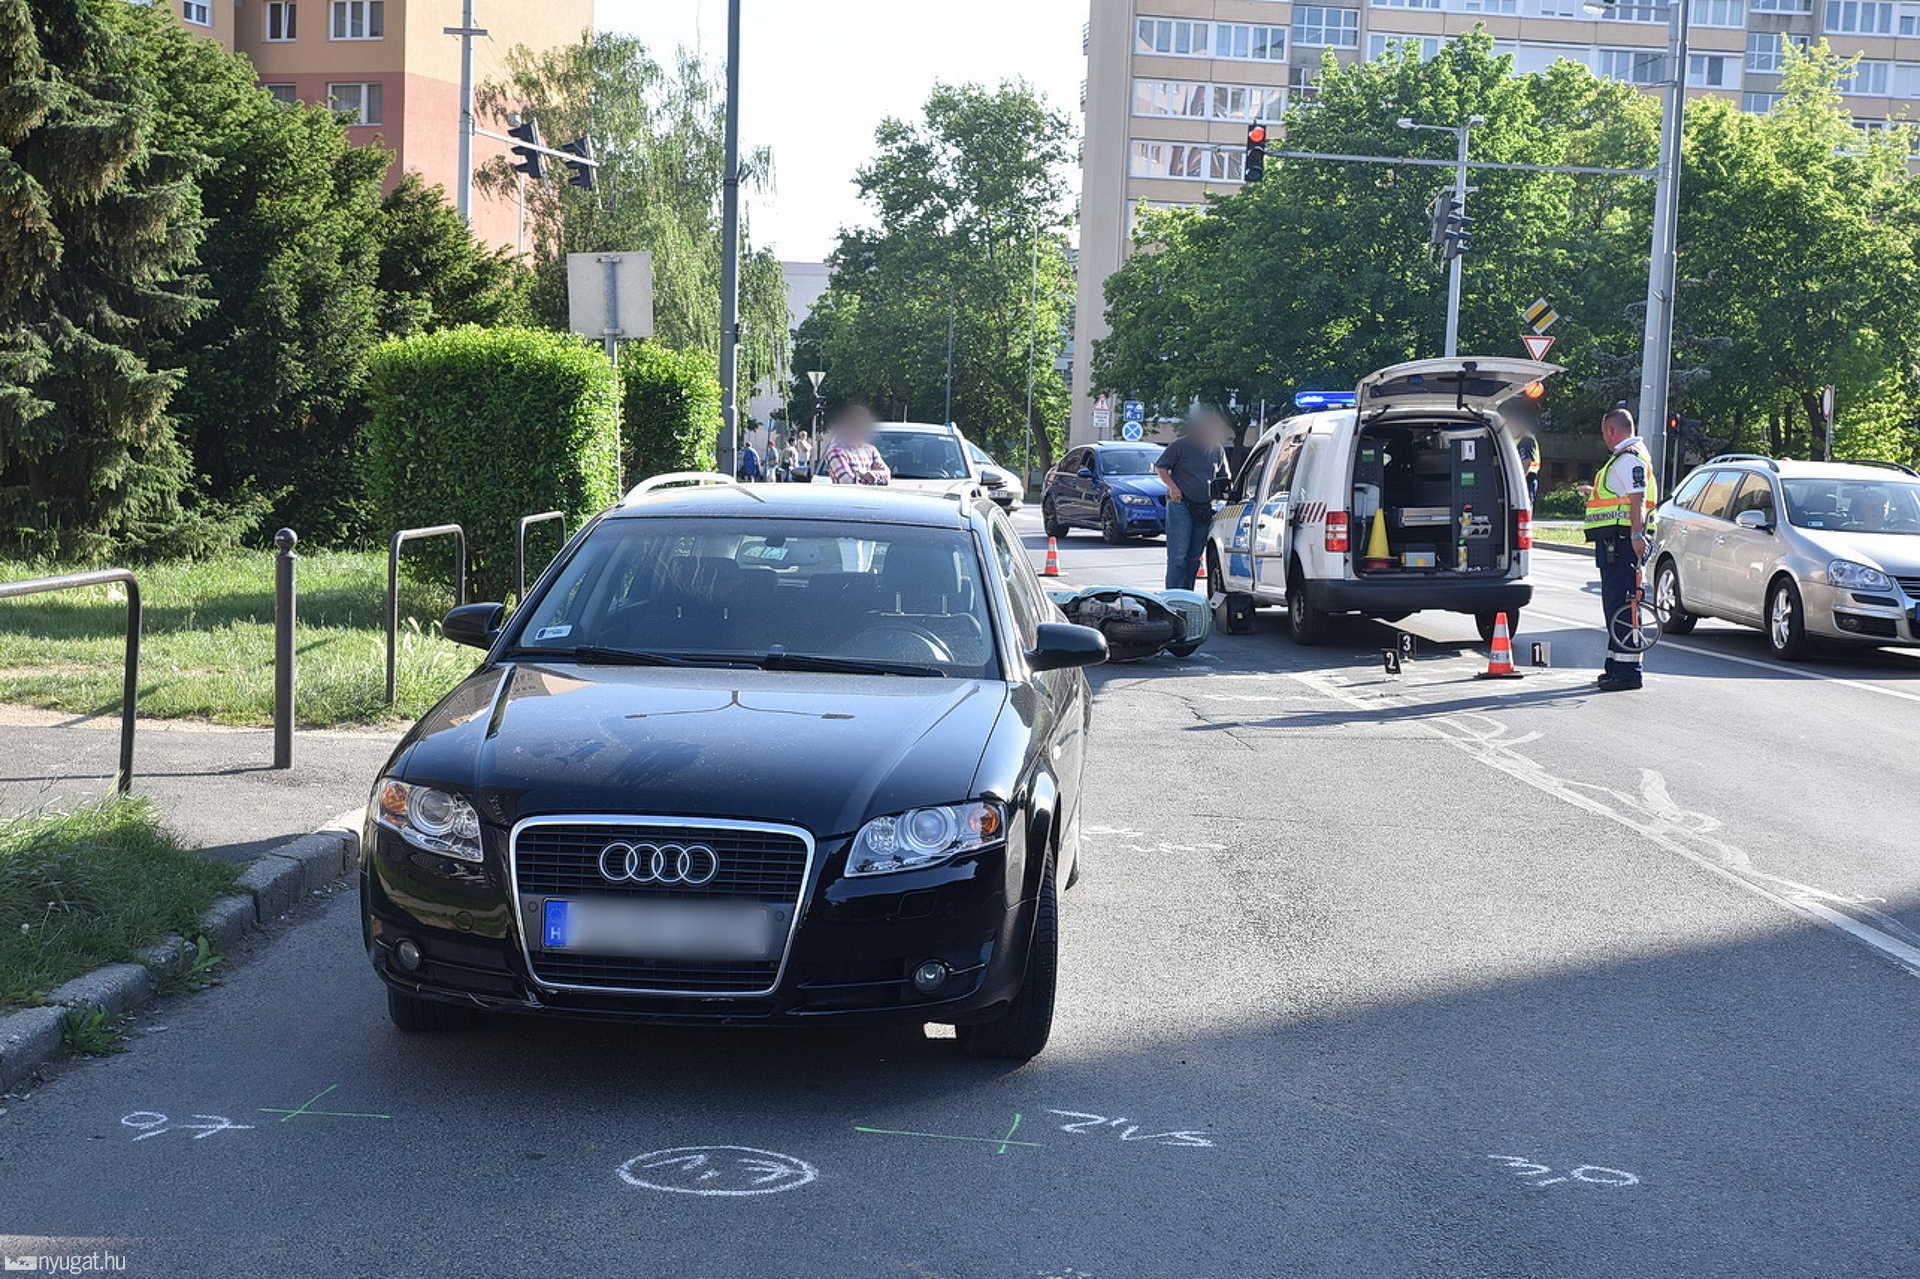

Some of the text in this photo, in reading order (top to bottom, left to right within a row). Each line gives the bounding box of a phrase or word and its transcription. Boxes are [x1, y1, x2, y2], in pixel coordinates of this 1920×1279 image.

[1403, 635, 1411, 651] 3
[1386, 652, 1396, 669] 2
[1534, 644, 1540, 662] 1
[550, 926, 561, 939] H
